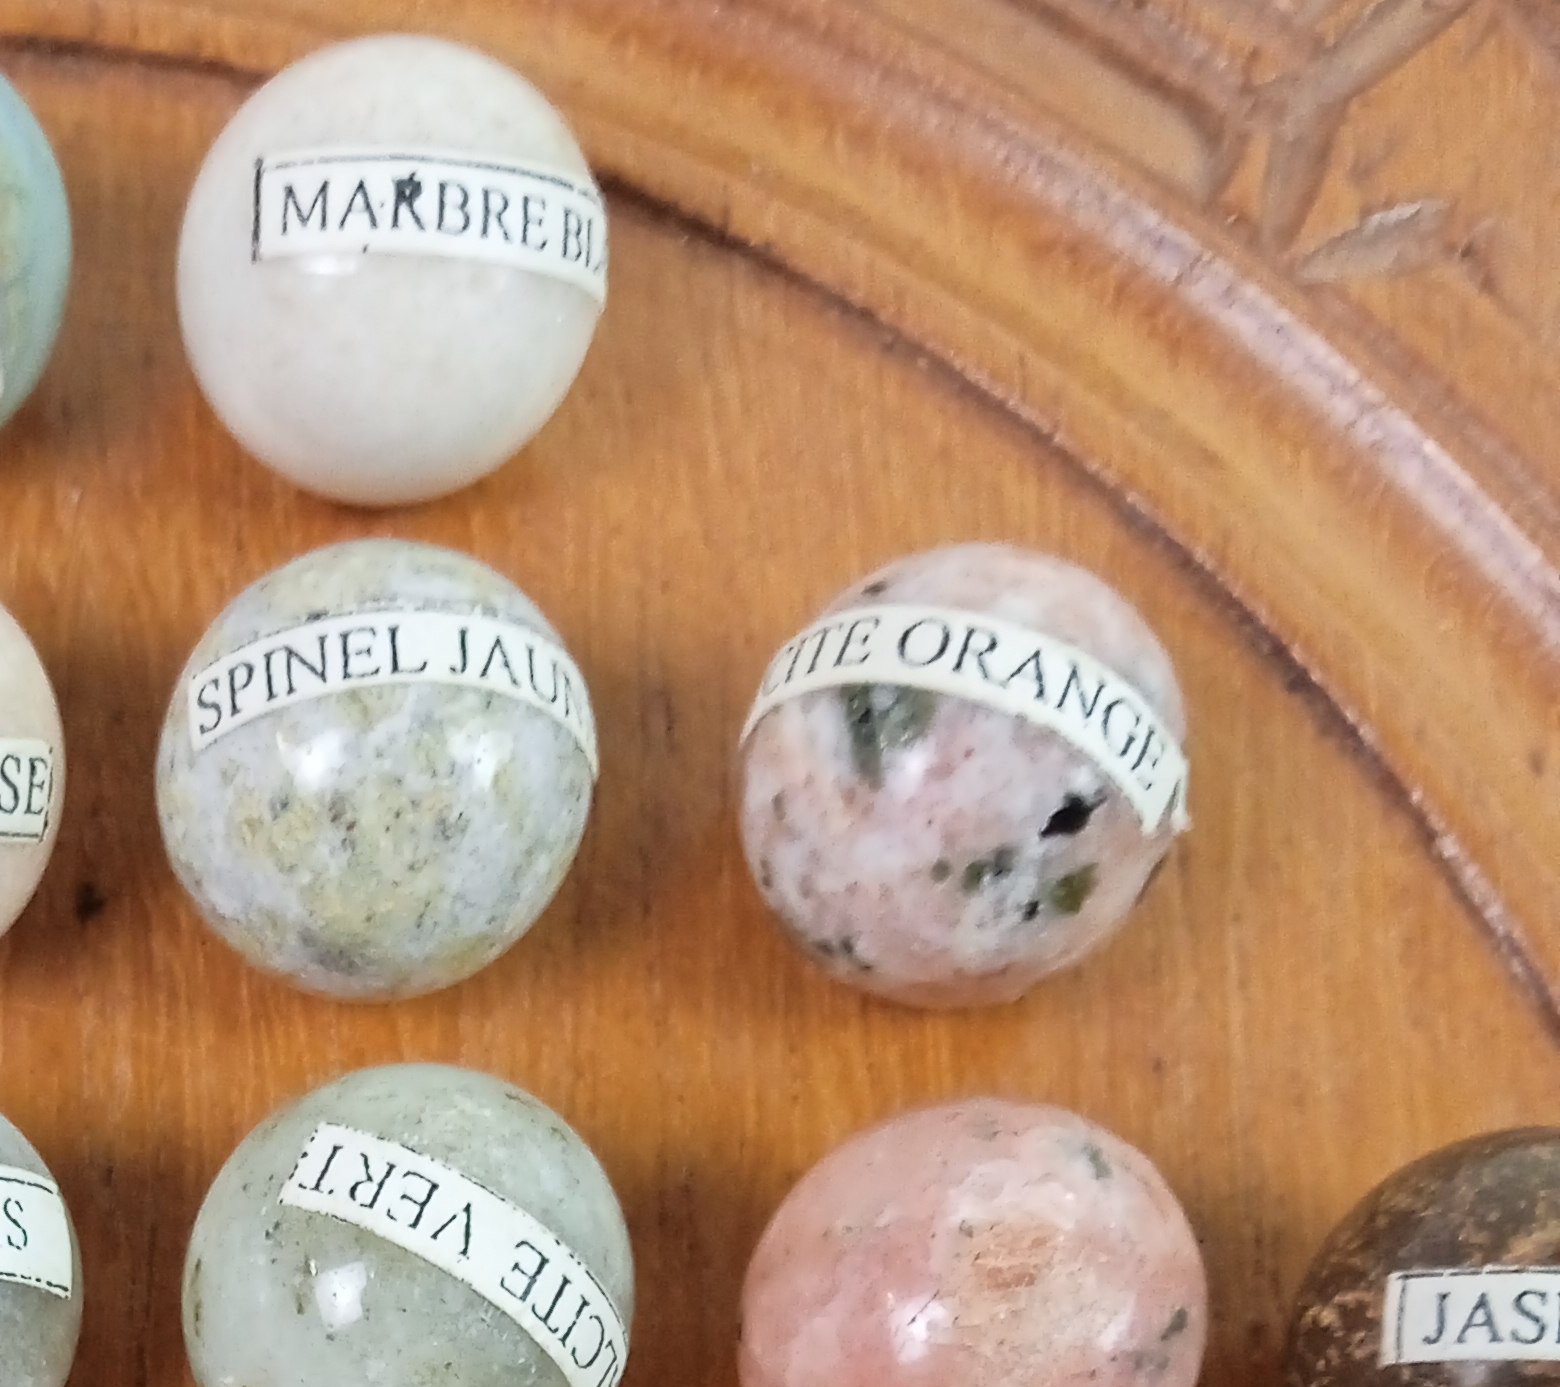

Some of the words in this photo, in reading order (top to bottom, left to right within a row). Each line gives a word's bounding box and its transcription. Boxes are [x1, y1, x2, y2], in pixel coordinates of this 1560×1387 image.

[281, 176, 548, 252] MARBRE
[196, 625, 428, 736] SPINEL
[897, 617, 1167, 791] ORANGE
[298, 1144, 474, 1258] VERT
[1421, 1289, 1560, 1347] JAS
